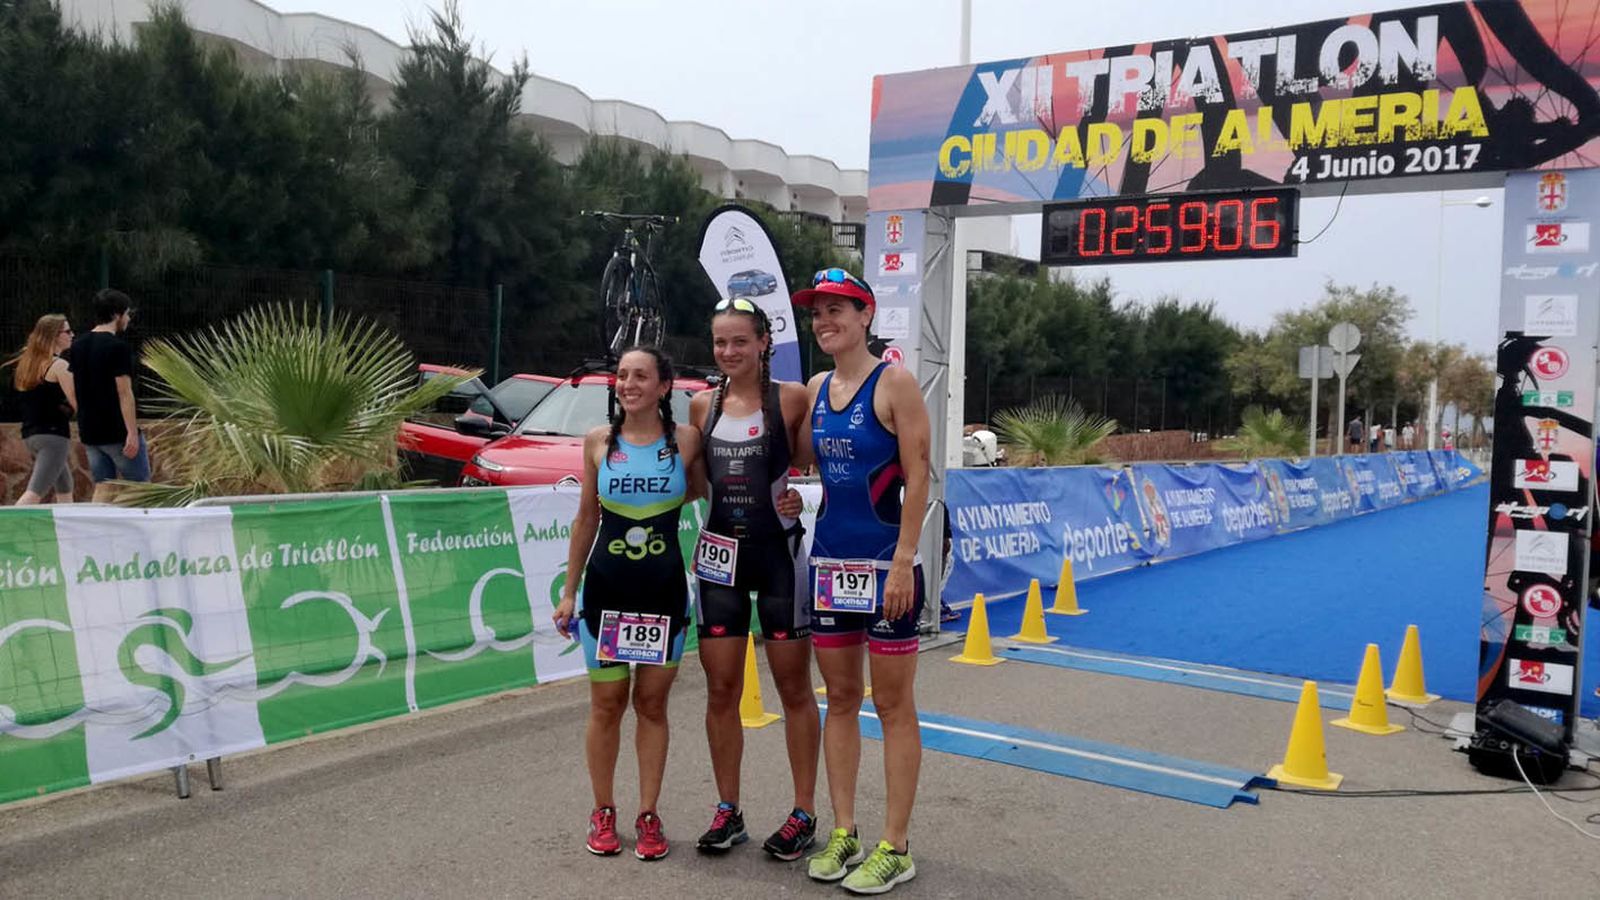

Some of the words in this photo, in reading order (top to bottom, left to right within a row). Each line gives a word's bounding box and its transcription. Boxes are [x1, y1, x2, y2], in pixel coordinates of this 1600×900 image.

[973, 65, 1054, 127] XII
[1066, 15, 1439, 116] TRIATLON
[938, 121, 1125, 178] CIUDAD
[1131, 112, 1204, 164] DE
[1211, 86, 1489, 157] ALMERIA
[1291, 155, 1310, 182] 4
[1316, 151, 1395, 179] Junio
[1405, 143, 1481, 173] 2017
[1078, 197, 1281, 257] 02:59:06
[713, 445, 764, 457] TRIATARFE
[608, 473, 672, 495] PÉREZ
[956, 501, 1052, 532] AYUNTAMIENTO
[407, 525, 514, 554] Federación
[701, 541, 730, 564] 190
[961, 537, 982, 563] DE
[77, 551, 232, 584] Andaluza
[241, 544, 273, 570] de
[278, 535, 380, 567] Triatlón
[835, 572, 870, 590] 197
[622, 624, 661, 643] 189
